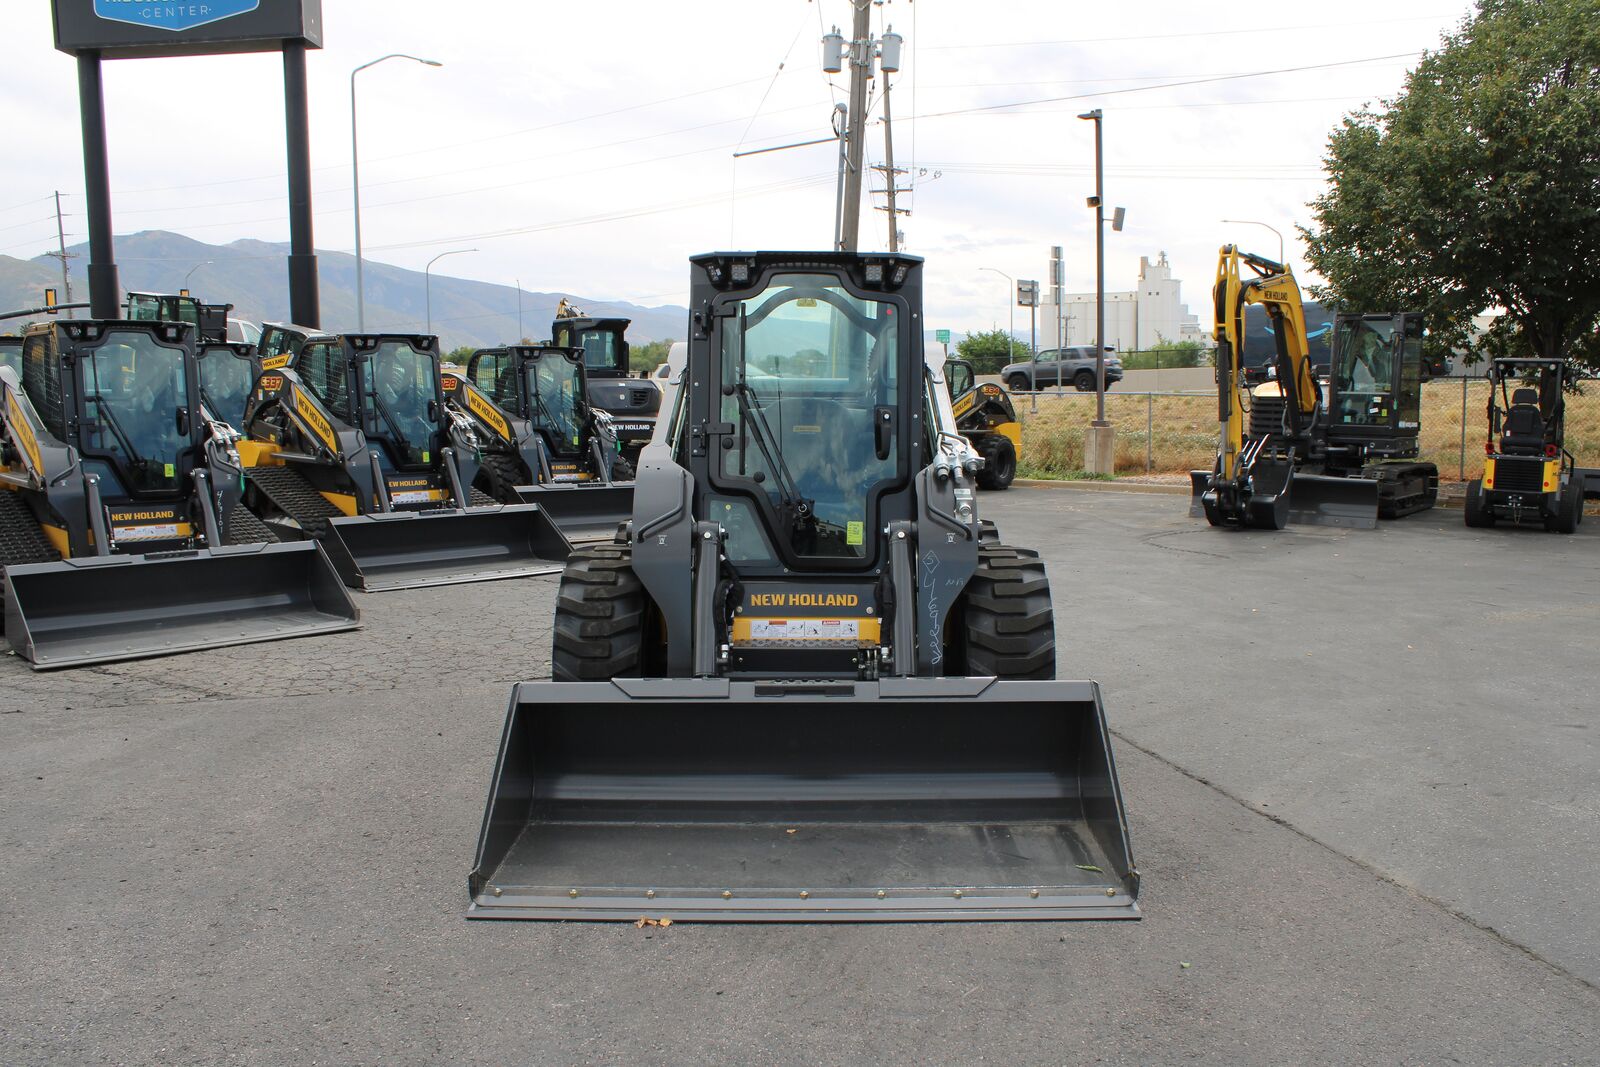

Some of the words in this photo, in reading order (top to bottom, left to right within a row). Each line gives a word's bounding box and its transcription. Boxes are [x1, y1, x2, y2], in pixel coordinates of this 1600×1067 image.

[142, 5, 209, 18] CENTER
[263, 358, 286, 367] HOLLAND
[299, 397, 310, 415] NEW
[309, 408, 331, 438] HOLLAND
[471, 396, 481, 411] NEW
[481, 405, 504, 429] HOLLAND
[112, 513, 132, 521] NEW
[134, 510, 174, 520] HOLLAND
[751, 594, 785, 607] NEW
[788, 593, 858, 607] HOLLAND
